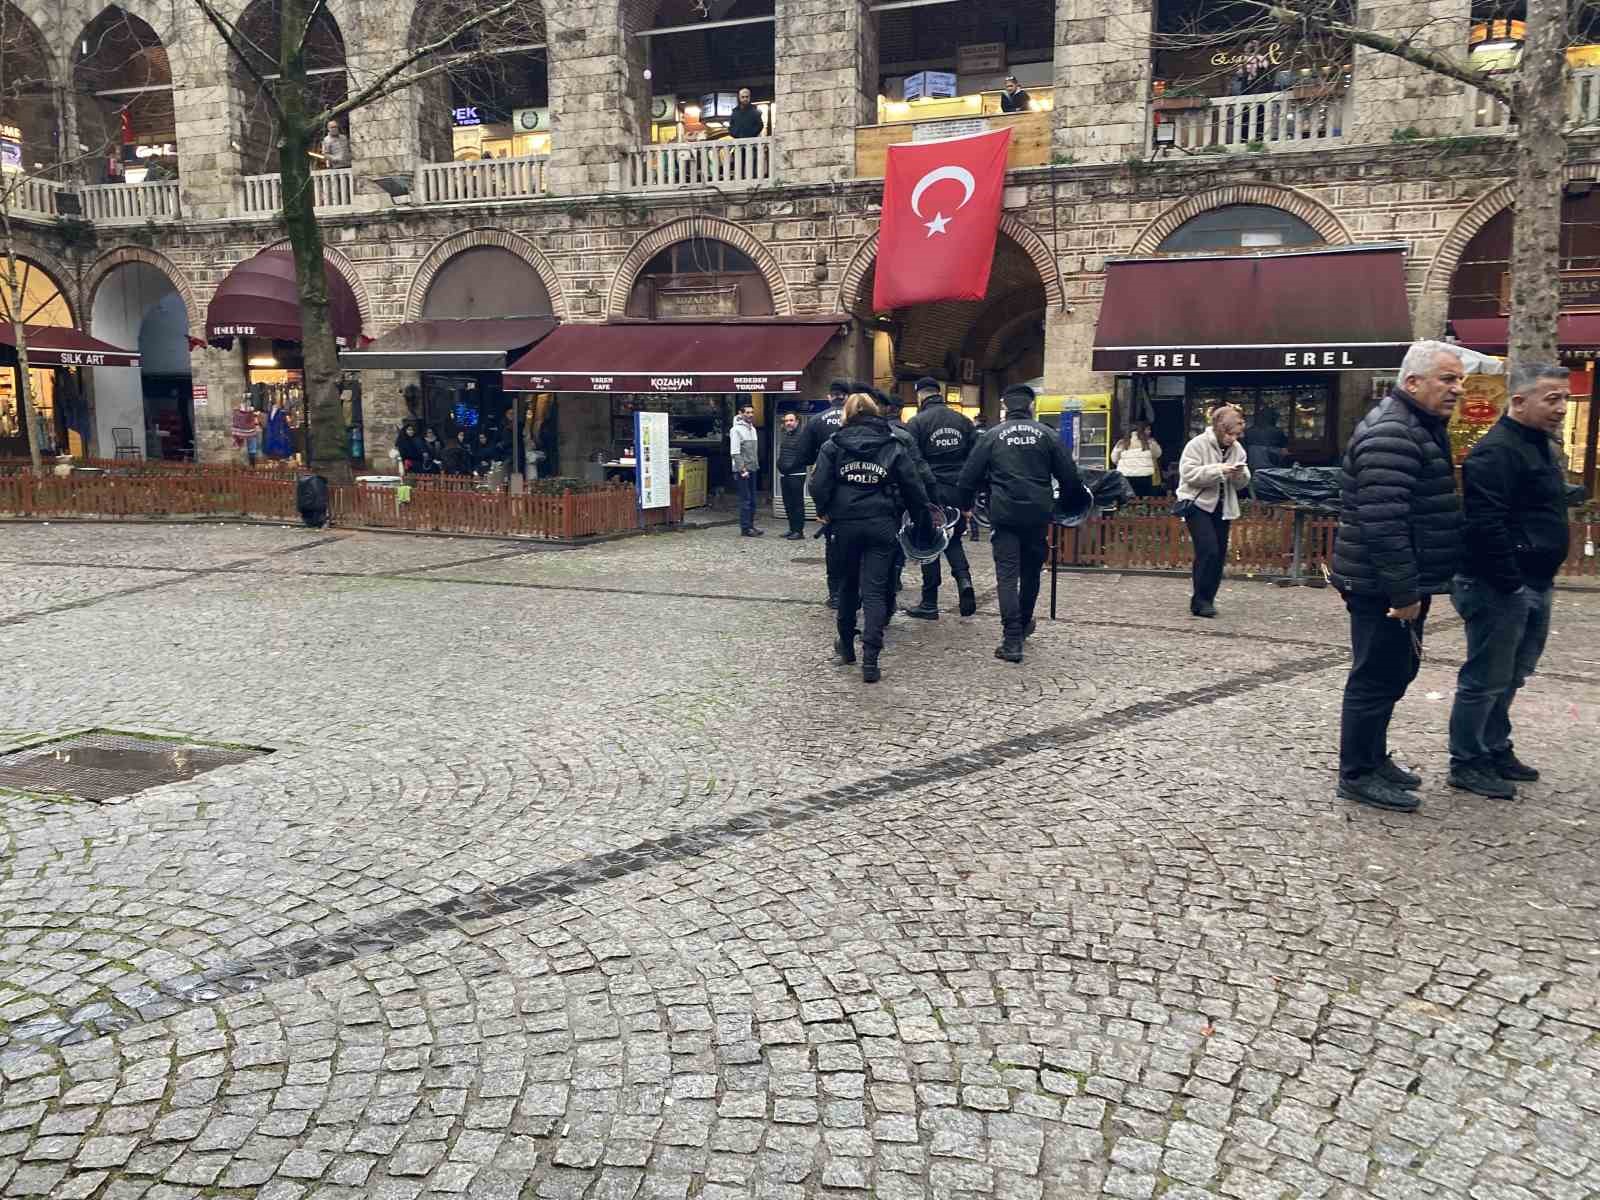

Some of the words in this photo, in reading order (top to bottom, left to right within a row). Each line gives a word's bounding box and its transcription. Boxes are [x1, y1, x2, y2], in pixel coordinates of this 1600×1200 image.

[60, 352, 82, 364] SILK
[86, 354, 104, 365] ART
[1136, 353, 1200, 367] EREL
[1284, 351, 1353, 366] EREL
[650, 377, 693, 390] KOZAHAN
